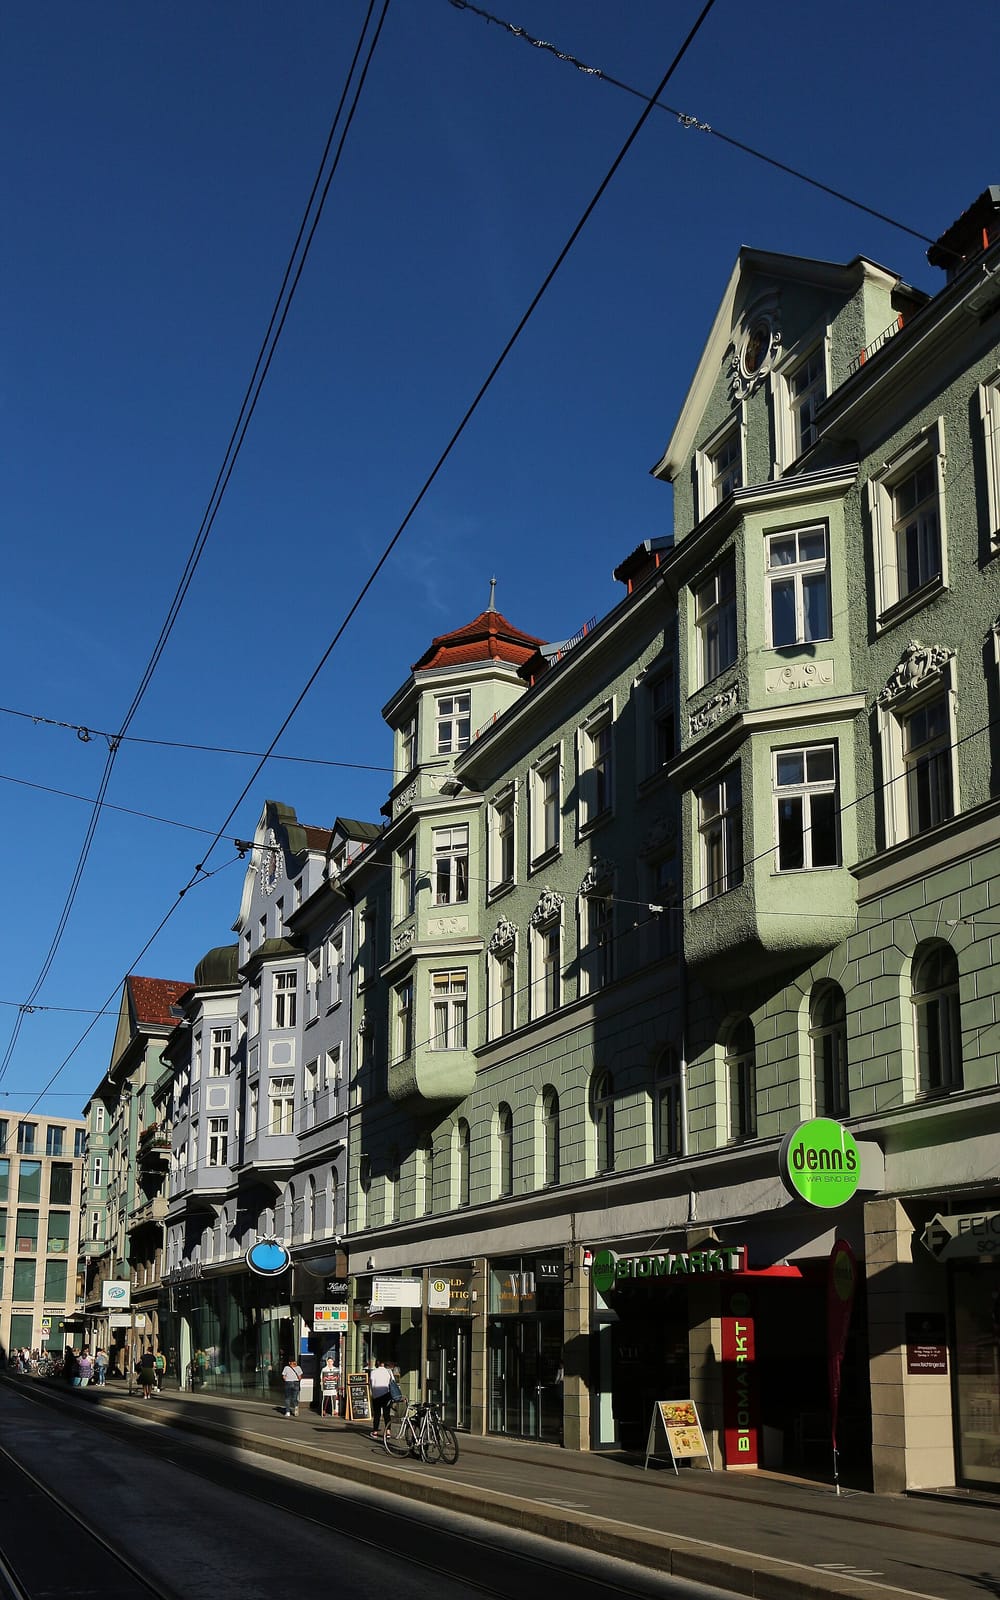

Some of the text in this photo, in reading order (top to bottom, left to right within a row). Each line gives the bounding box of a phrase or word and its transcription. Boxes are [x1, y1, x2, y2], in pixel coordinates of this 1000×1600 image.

[806, 1175, 857, 1183] WIR SIND BIO
[541, 1265, 559, 1274] VIU
[616, 1247, 740, 1279] BIOMARKT
[735, 1321, 750, 1452] BIOMARKT
